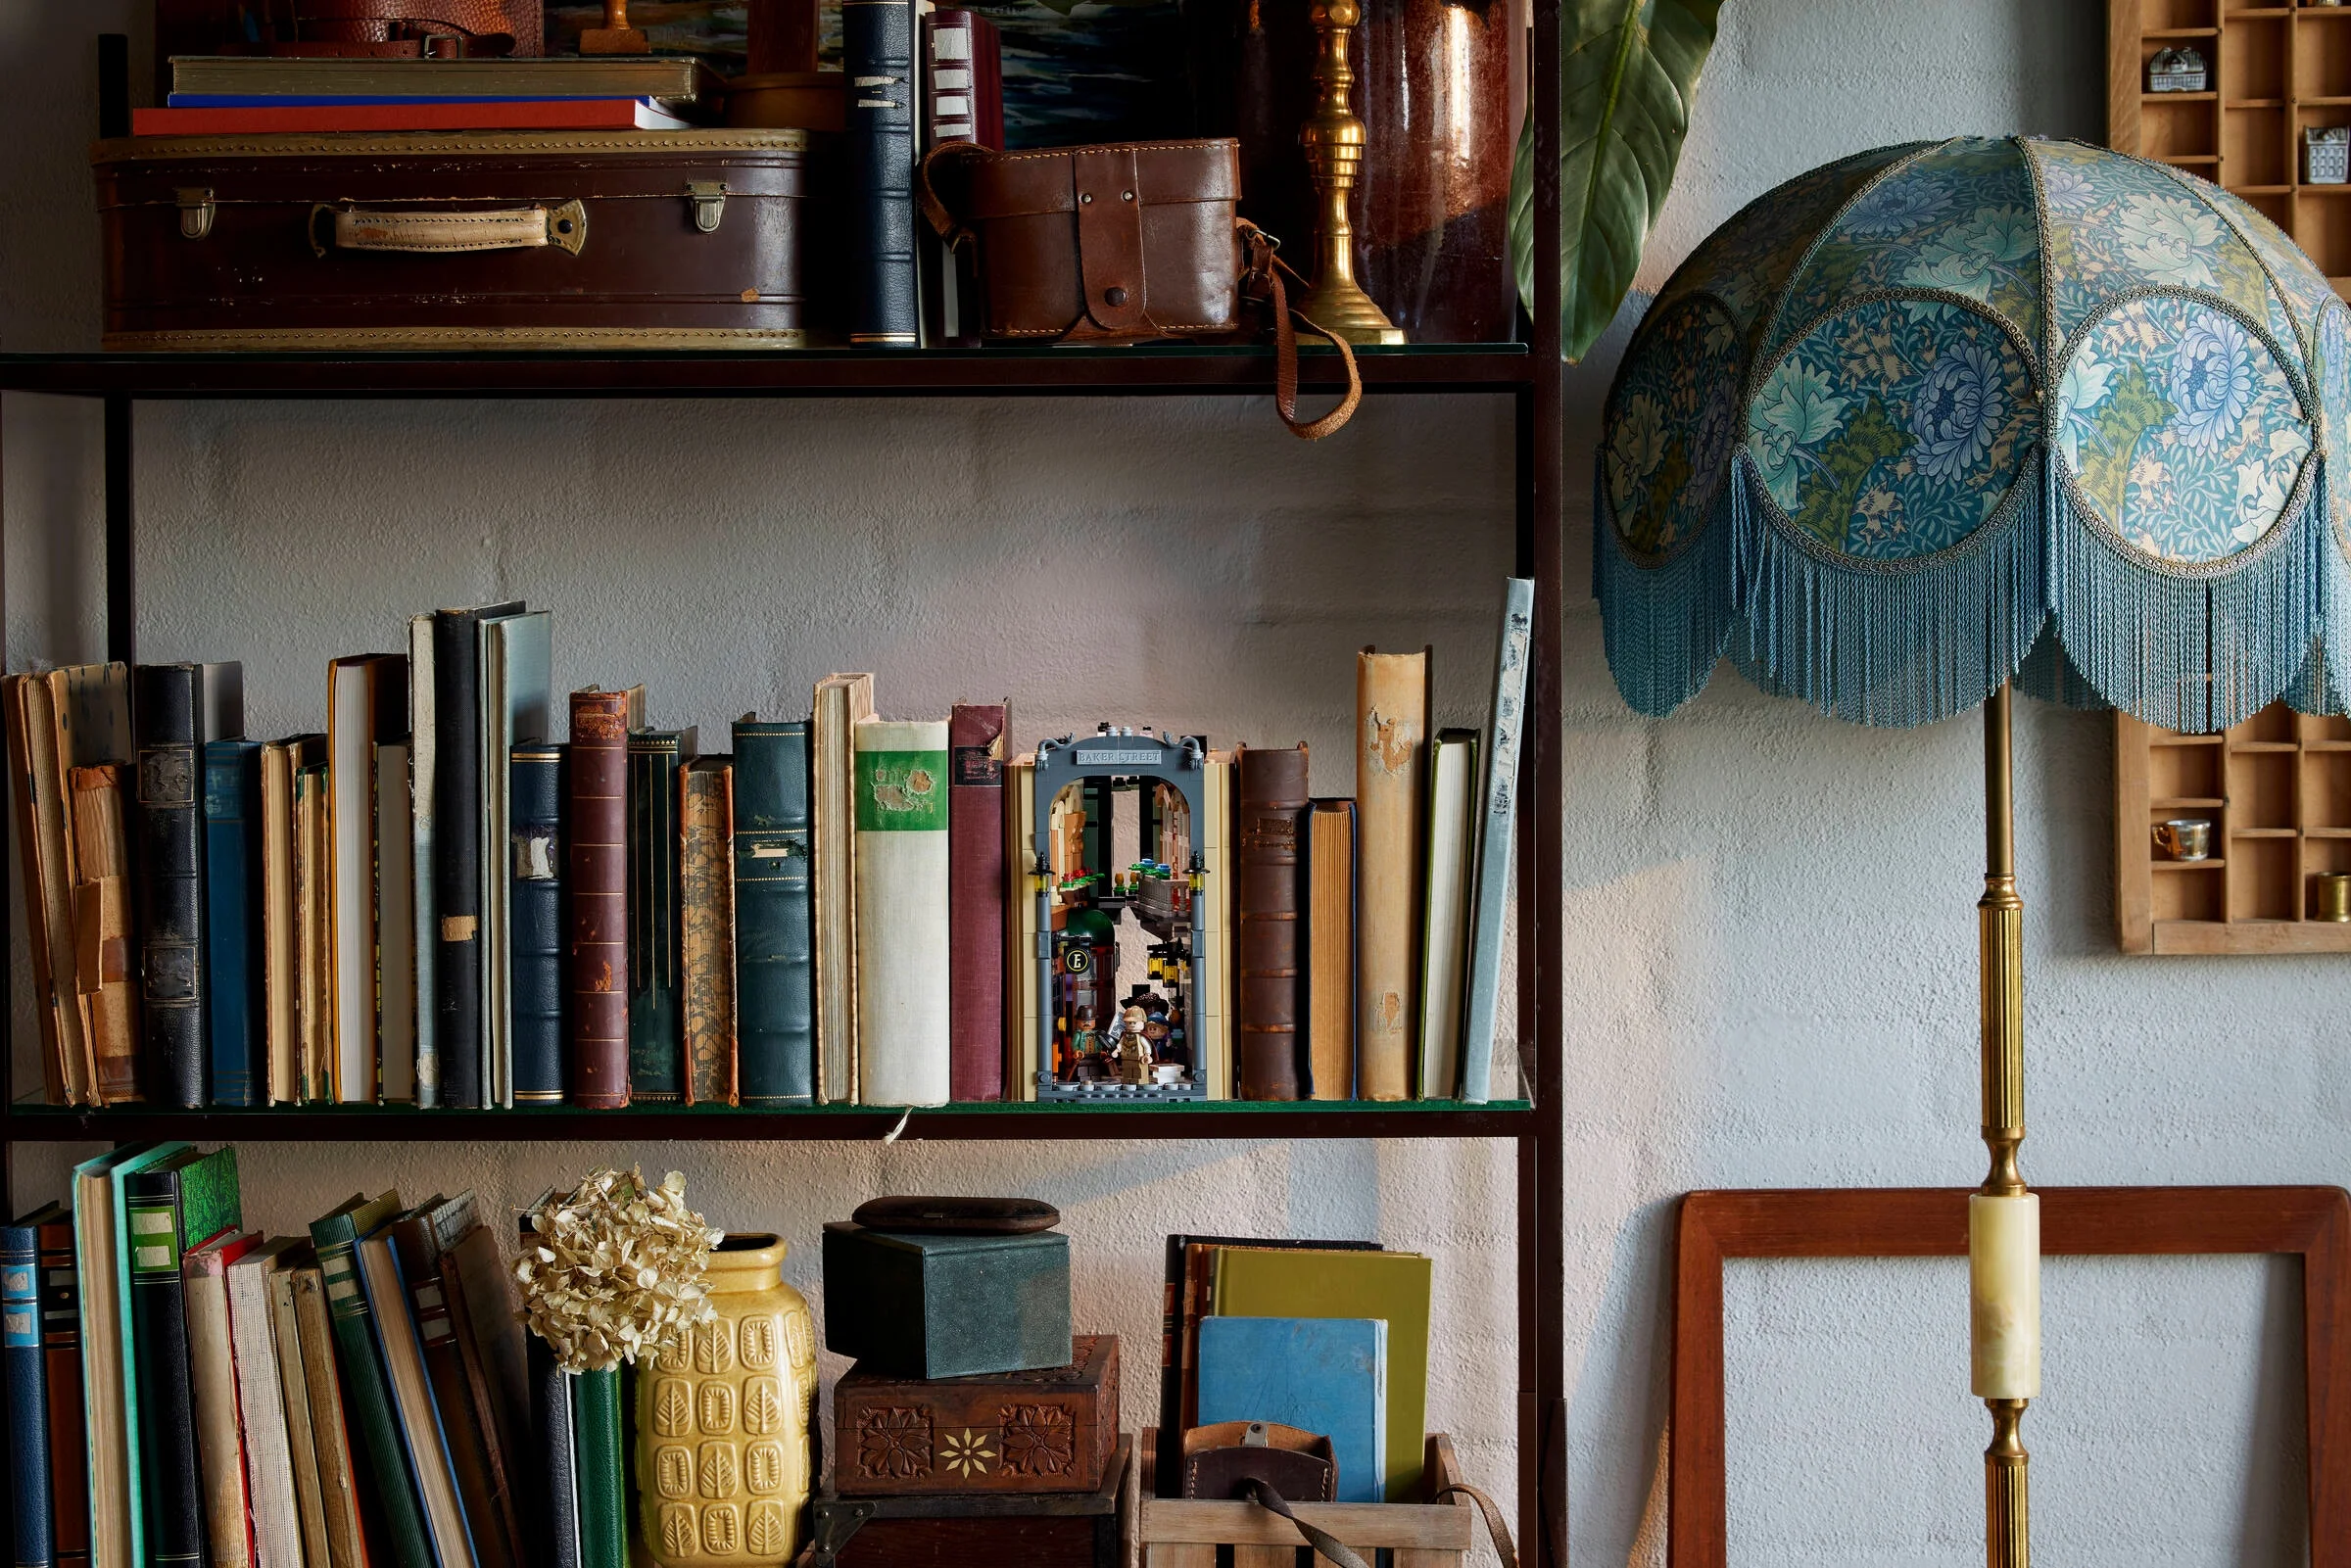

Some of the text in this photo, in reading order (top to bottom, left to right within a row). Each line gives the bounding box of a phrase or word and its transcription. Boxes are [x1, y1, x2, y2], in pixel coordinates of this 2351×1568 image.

[1079, 751, 1161, 762] BAKER STREET
[1073, 953, 1081, 969] E
